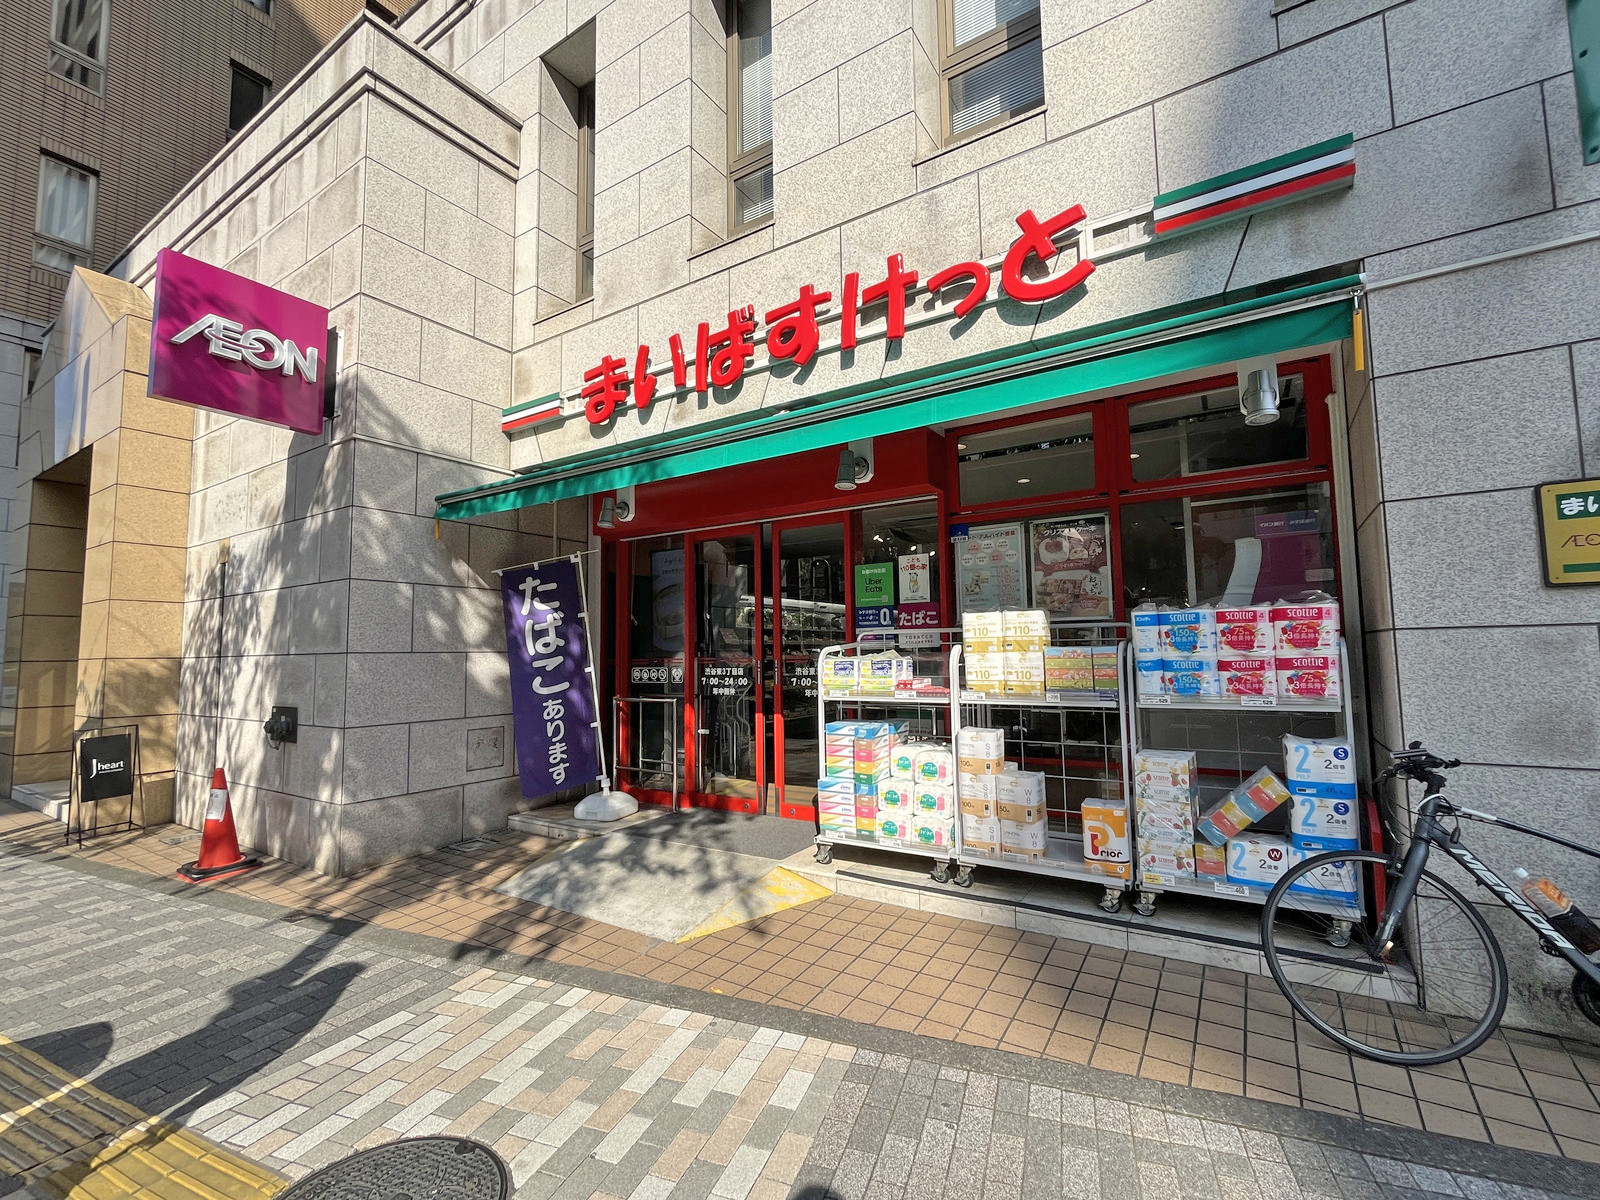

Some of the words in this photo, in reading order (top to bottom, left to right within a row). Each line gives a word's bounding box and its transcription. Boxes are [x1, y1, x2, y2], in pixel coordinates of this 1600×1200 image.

[580, 203, 1097, 425] まいばすけっと
[169, 313, 319, 384] AEON
[864, 578, 882, 586] Uber
[865, 585, 883, 593] Eats
[899, 610, 939, 627] たばこ
[1295, 625, 1313, 633] 75m
[985, 750, 991, 758] 8
[1294, 744, 1311, 774] 2
[1300, 798, 1317, 828] 2
[989, 826, 995, 834] S
[1030, 832, 1039, 840] W
[1232, 842, 1247, 871] 2
[1269, 850, 1281, 859] W
[1450, 848, 1576, 950] MERIDA
